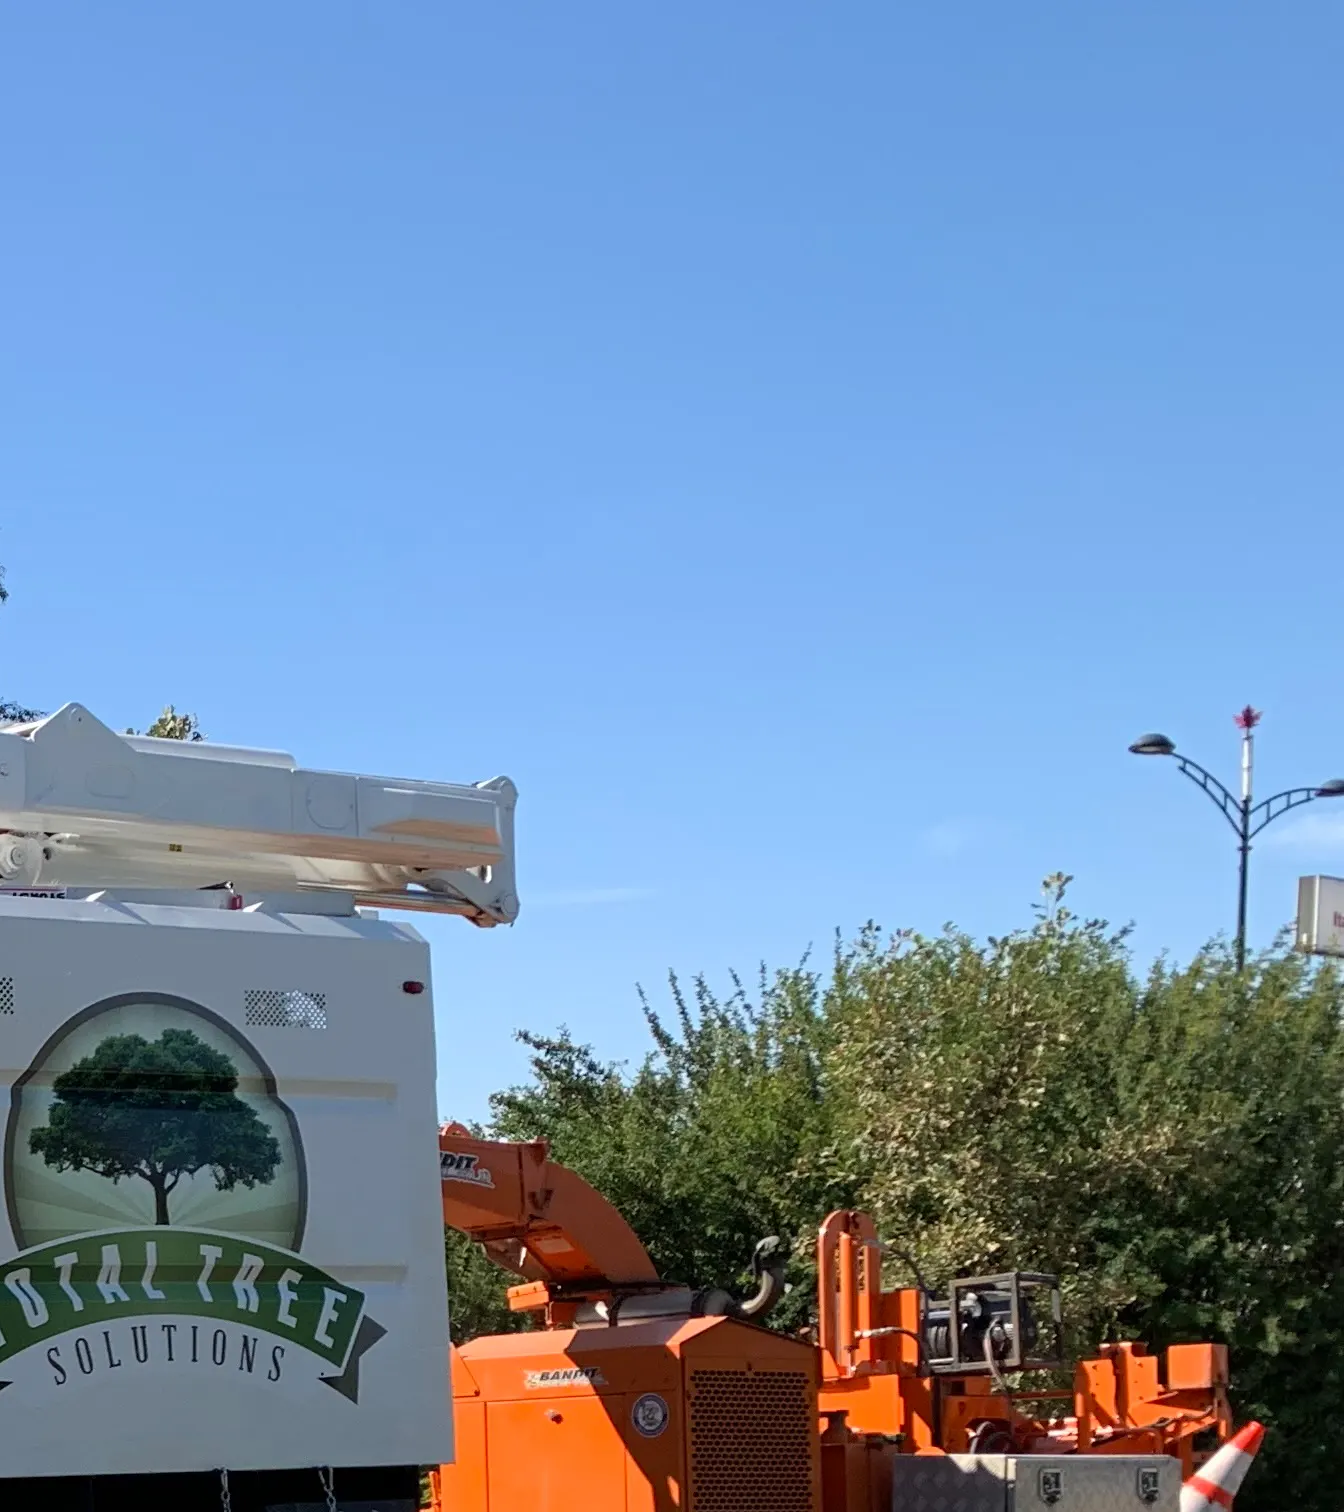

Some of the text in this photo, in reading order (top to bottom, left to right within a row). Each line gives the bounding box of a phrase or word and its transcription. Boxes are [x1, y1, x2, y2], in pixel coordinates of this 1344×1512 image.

[196, 1243, 348, 1349] TREE
[46, 1324, 287, 1386] SOLUTIONS
[539, 1367, 598, 1382] BANDIT
